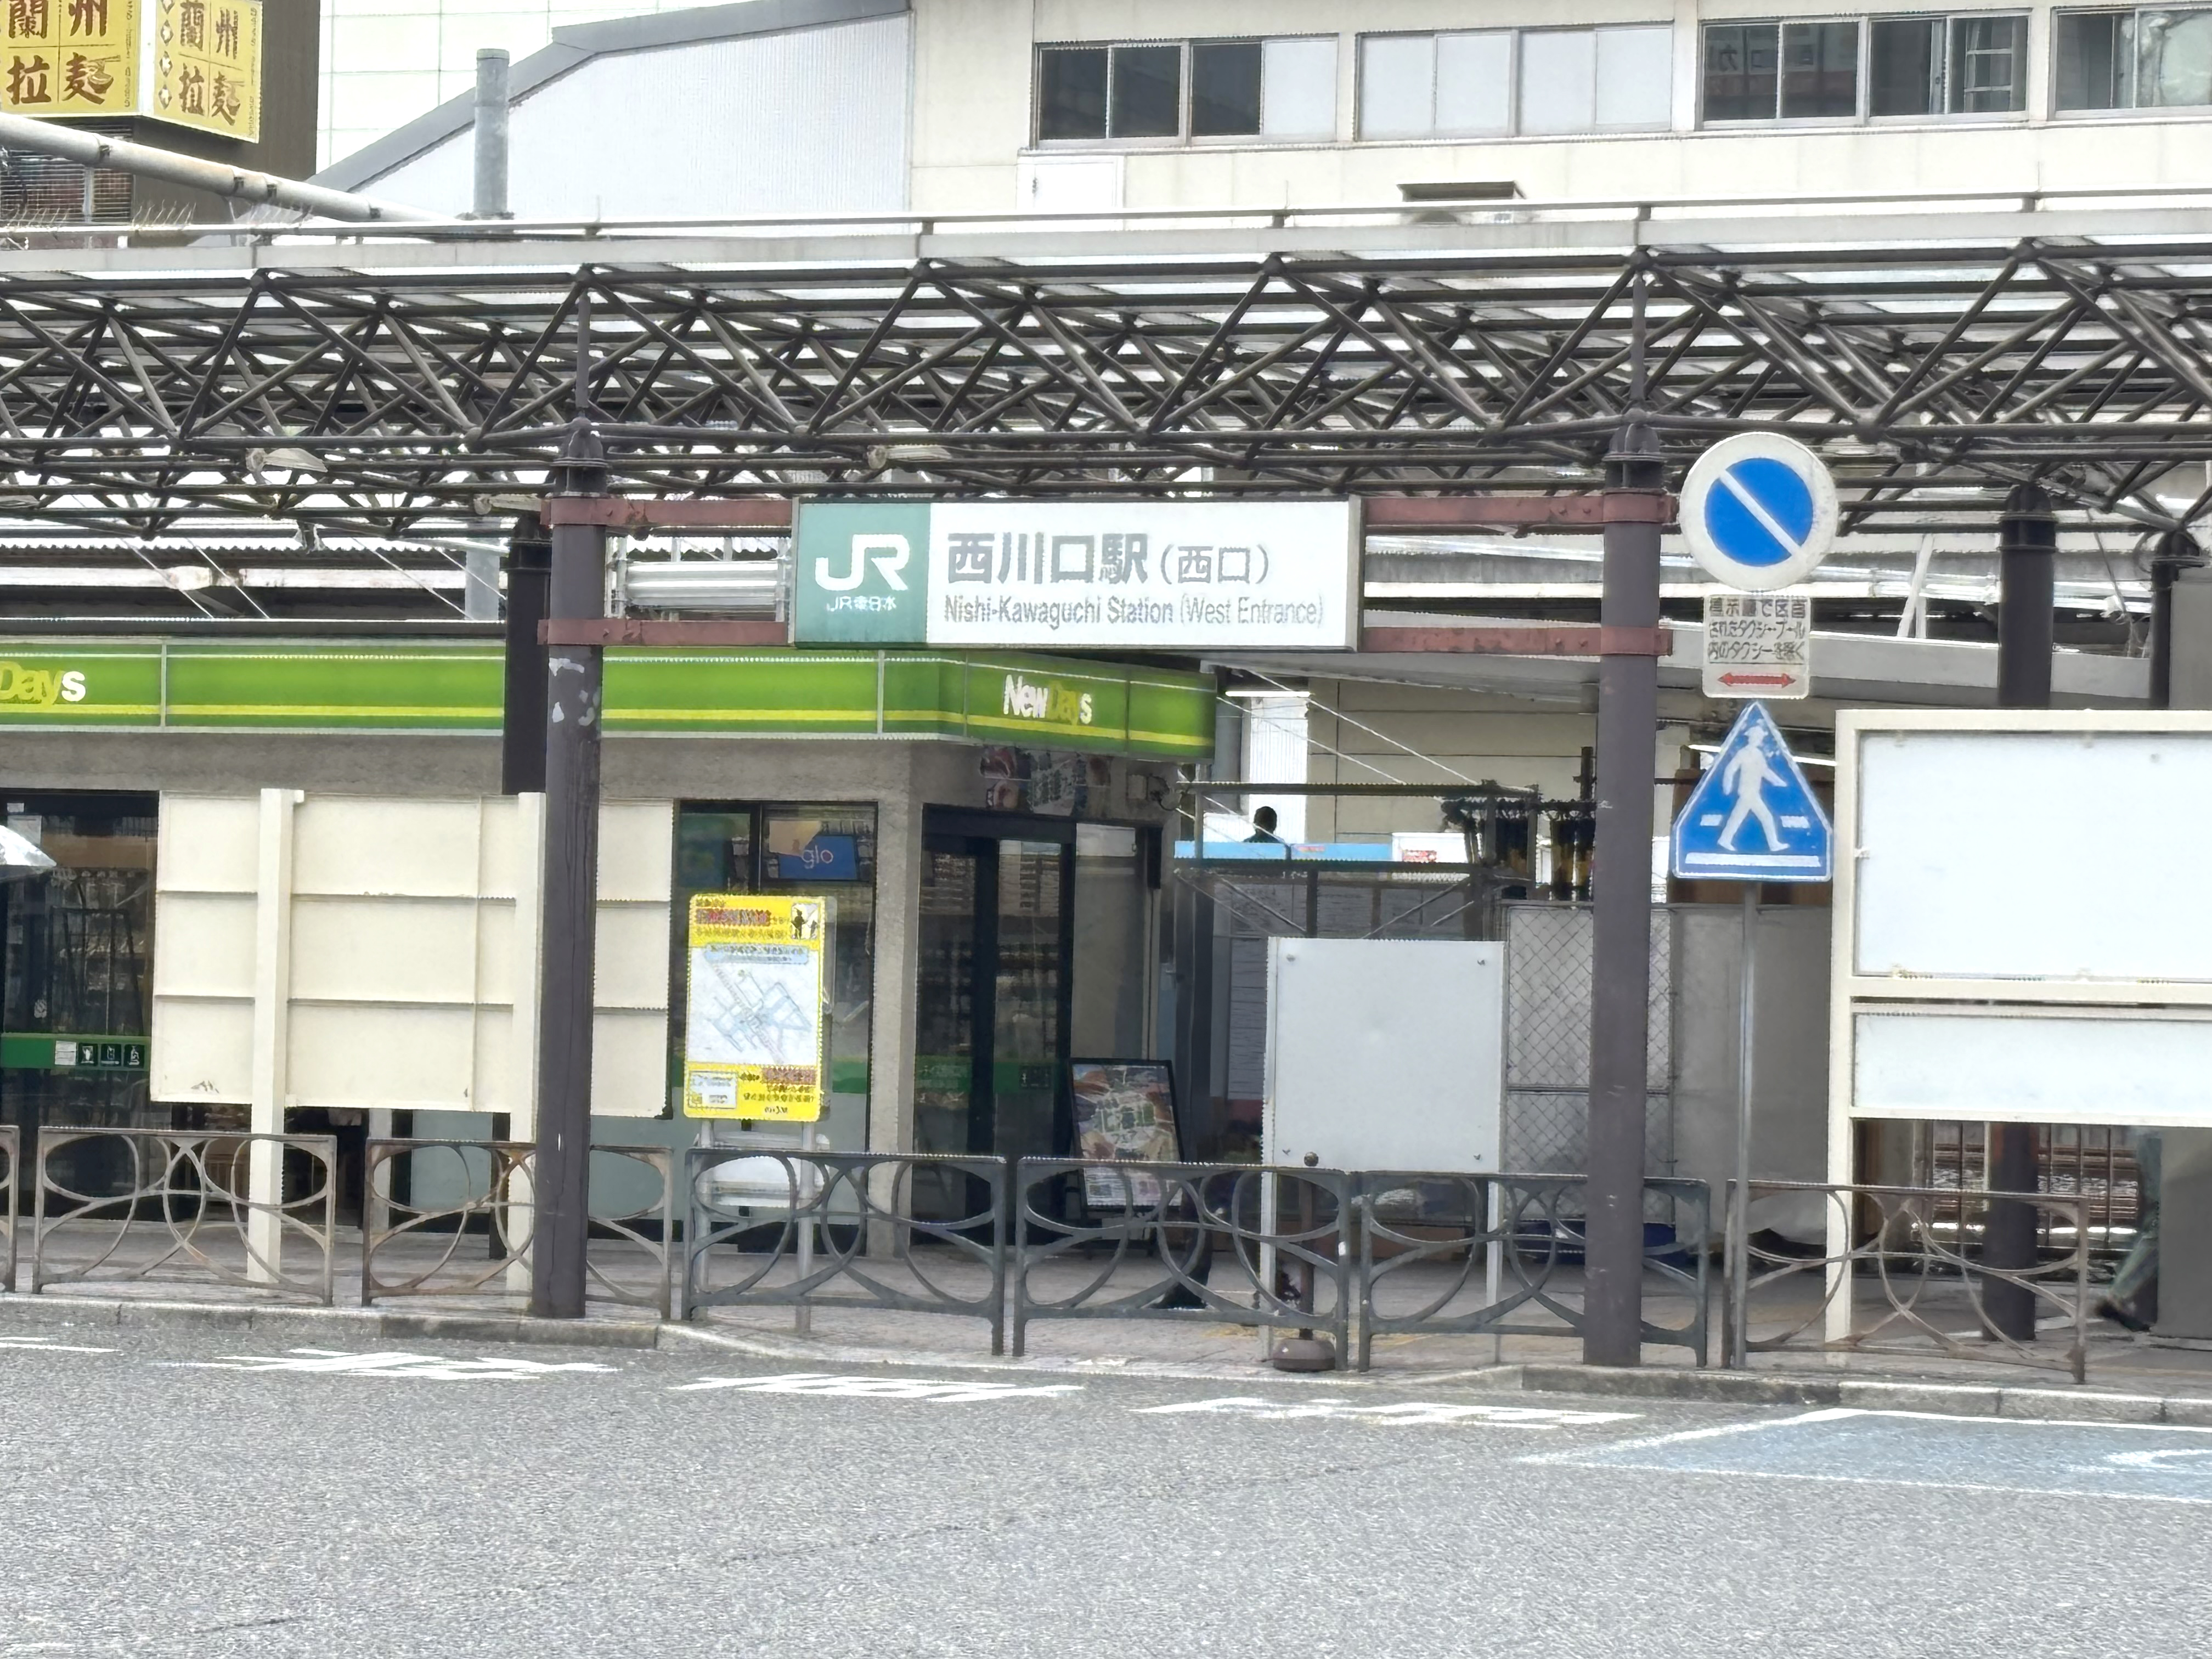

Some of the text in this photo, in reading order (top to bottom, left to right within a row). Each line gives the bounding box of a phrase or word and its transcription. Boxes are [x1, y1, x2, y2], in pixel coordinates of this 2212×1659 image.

[815, 534, 910, 591] JR
[944, 593, 1324, 630] Nishi-Kawaguchi Station (West Entrance)
[801, 845, 834, 870] glo
